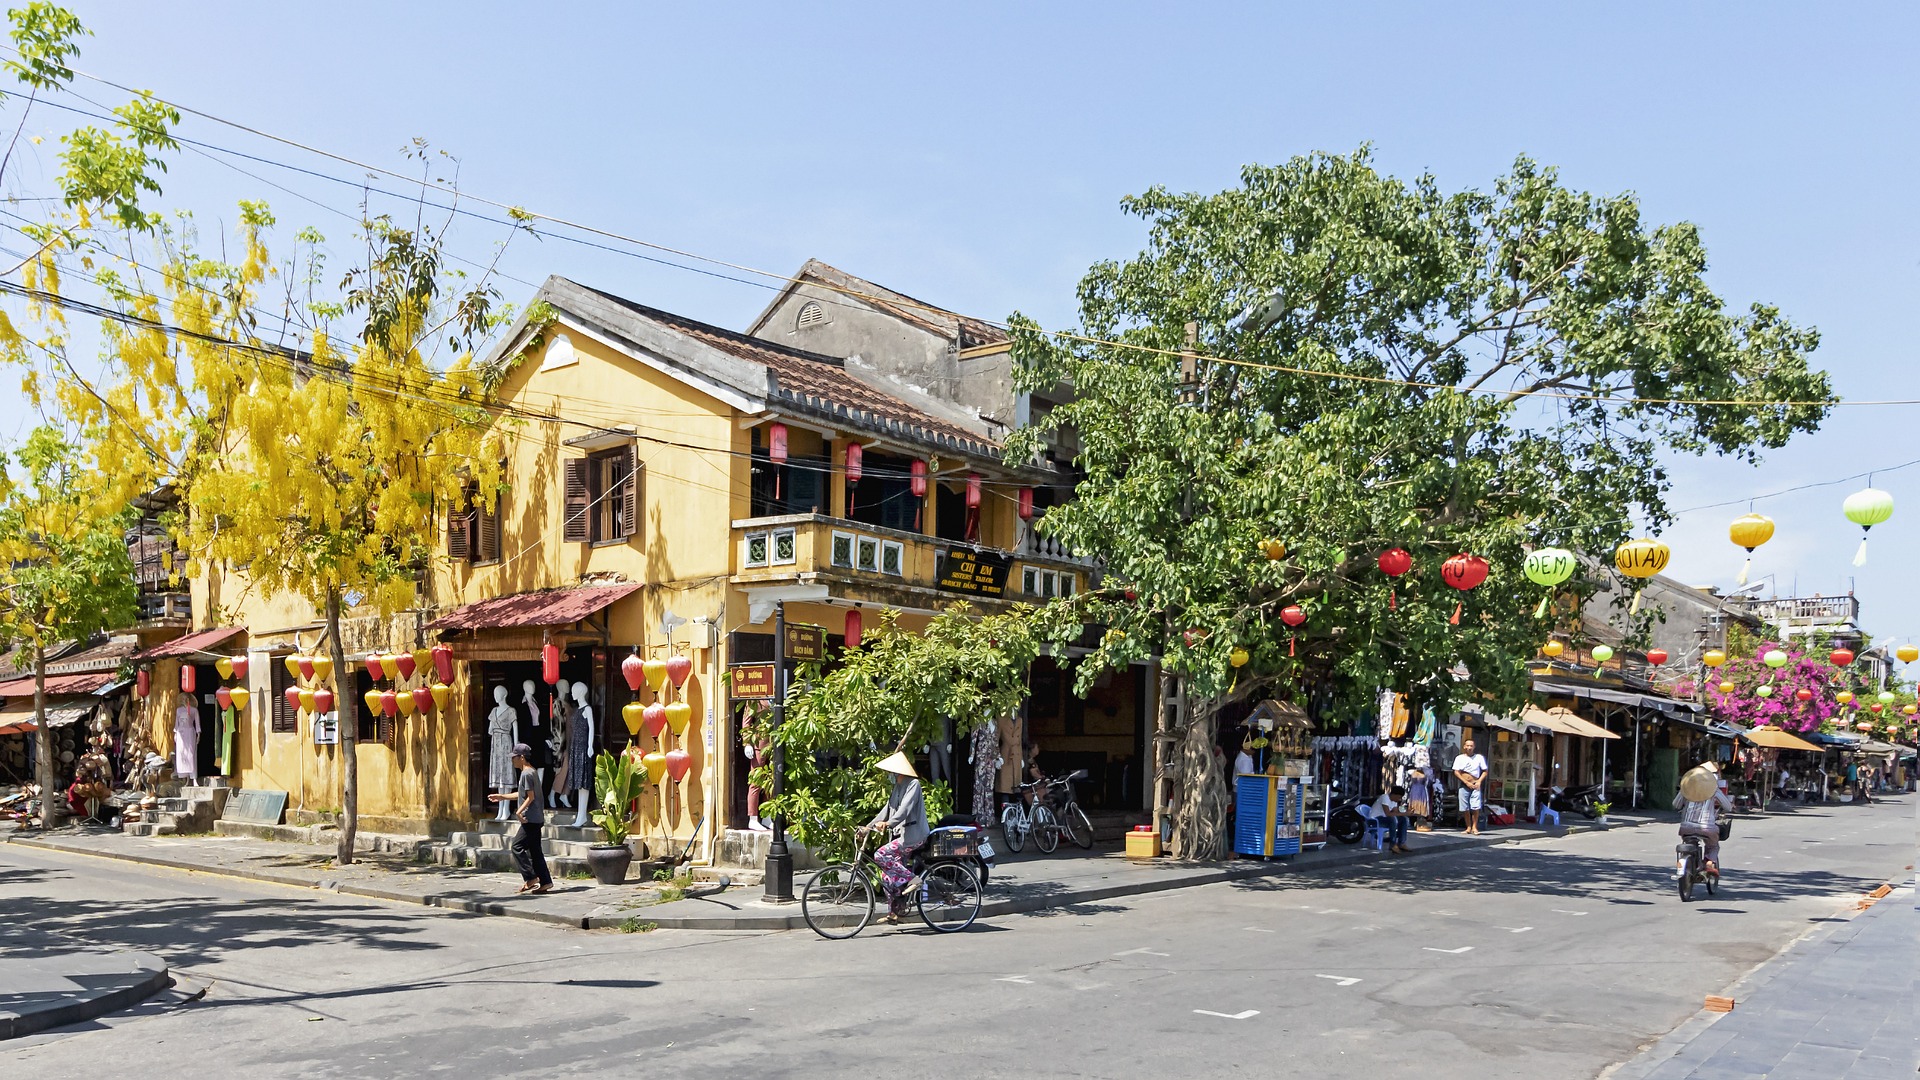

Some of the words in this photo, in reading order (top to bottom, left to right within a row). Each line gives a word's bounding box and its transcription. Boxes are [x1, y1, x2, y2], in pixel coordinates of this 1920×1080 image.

[980, 565, 993, 576] EM
[951, 571, 972, 580] SISTERS
[975, 575, 993, 583] TAILOR
